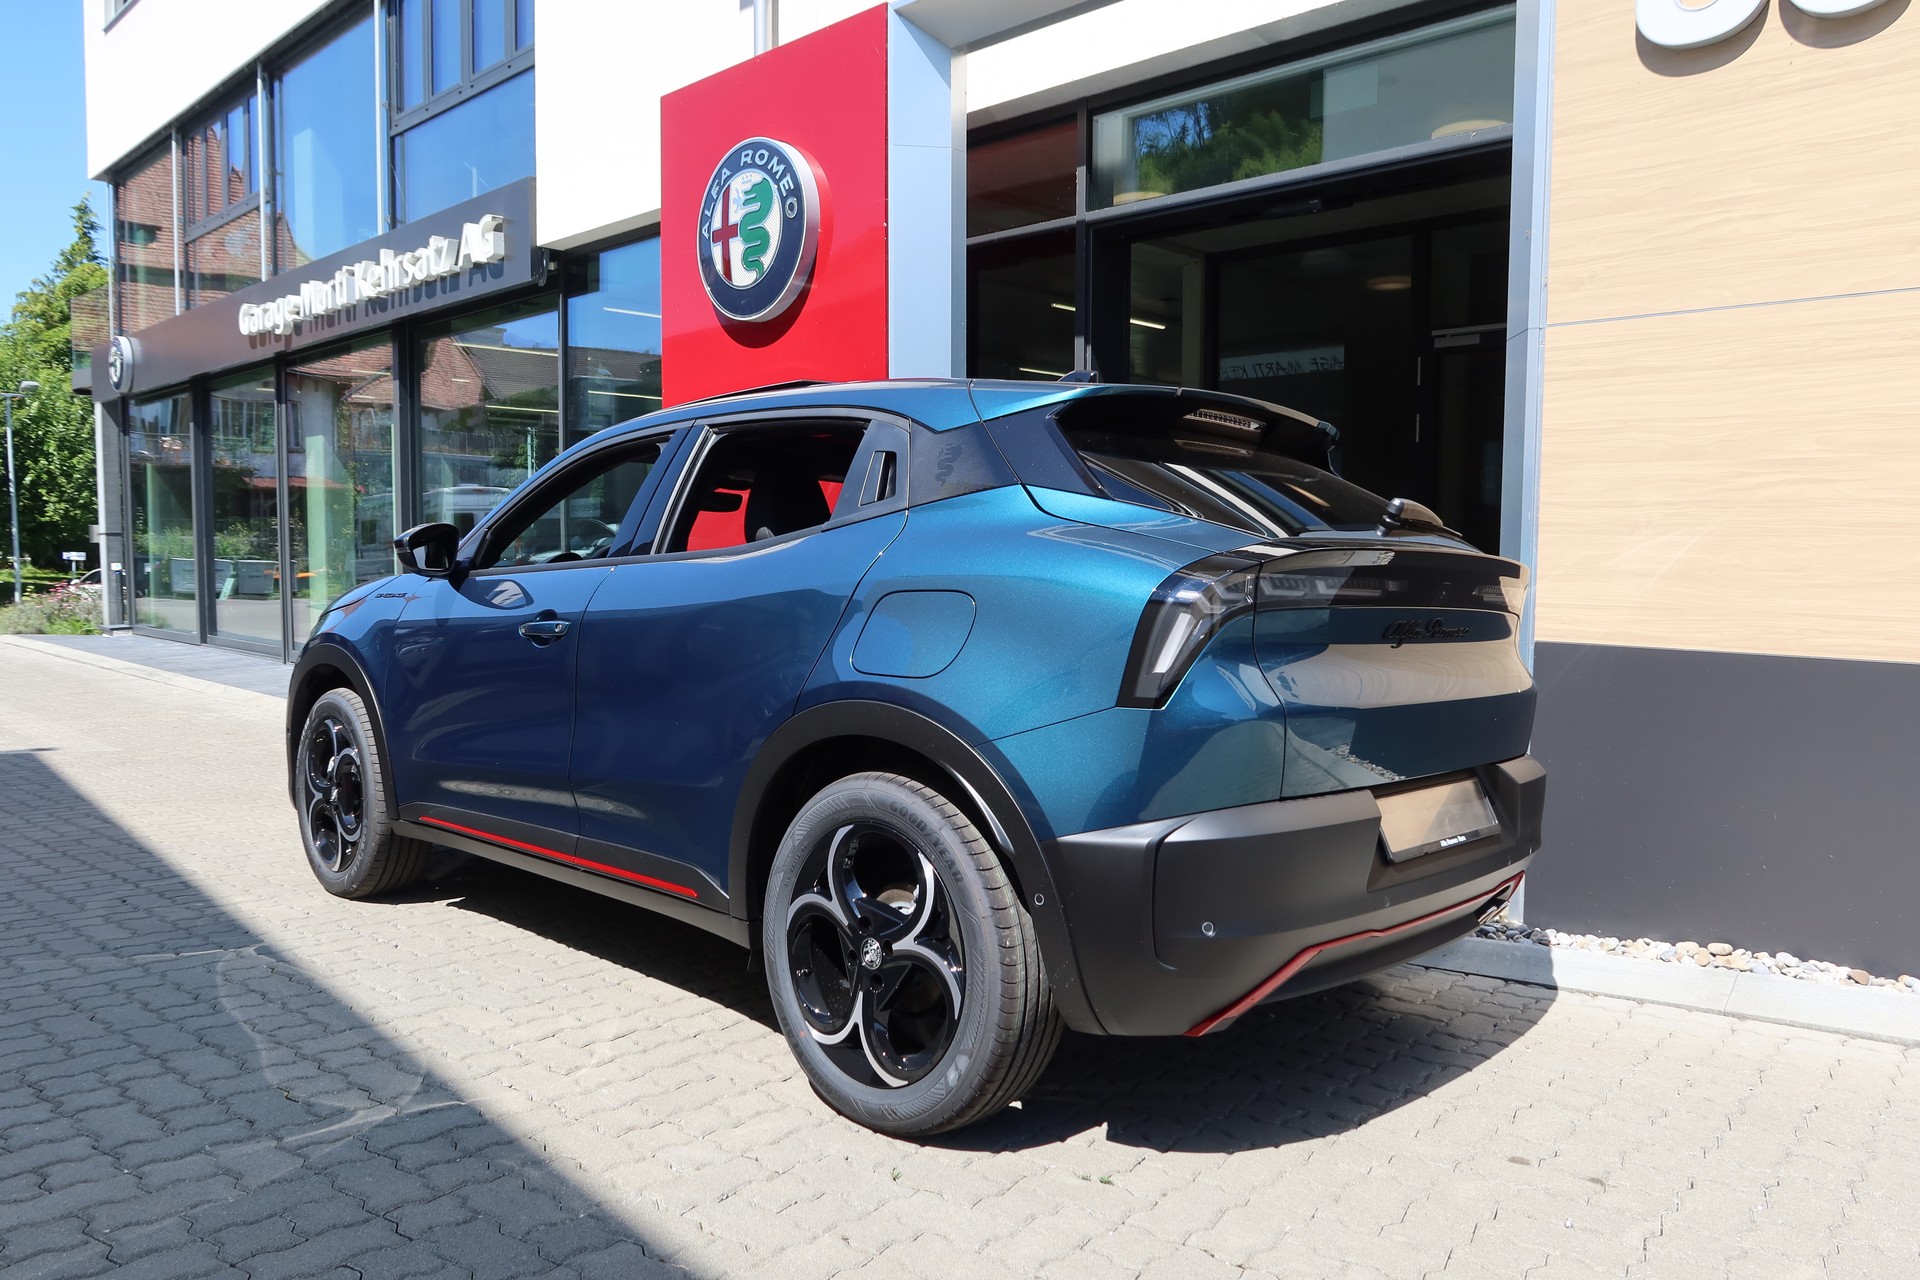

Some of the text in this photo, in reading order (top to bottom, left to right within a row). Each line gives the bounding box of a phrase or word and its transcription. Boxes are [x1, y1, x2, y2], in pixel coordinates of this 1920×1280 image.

[702, 148, 798, 240] ALFA ROMEO
[239, 213, 505, 335] Garage Marti Kehrsatz AG
[1382, 617, 1472, 649] Alfa Romeo
[889, 800, 964, 885] GOODYEAR
